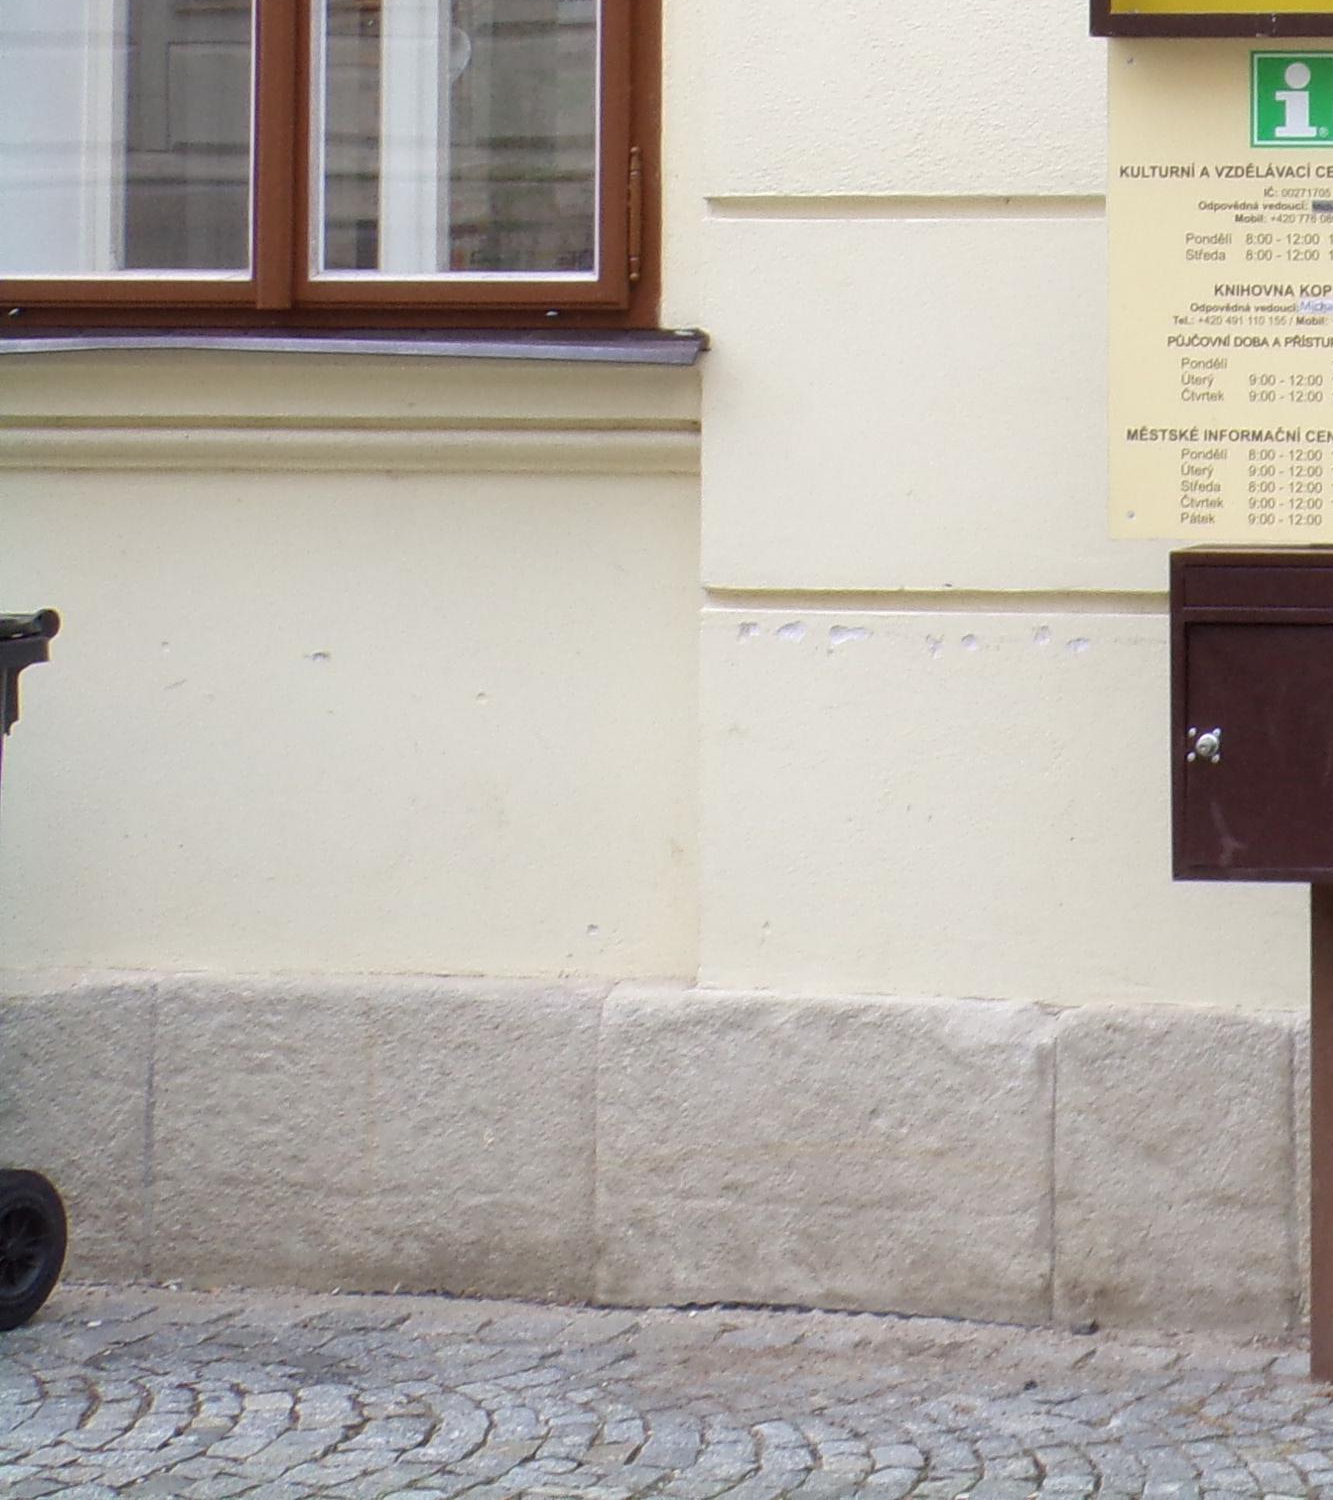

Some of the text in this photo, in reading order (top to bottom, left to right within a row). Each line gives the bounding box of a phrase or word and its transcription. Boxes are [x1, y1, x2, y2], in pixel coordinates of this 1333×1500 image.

[1120, 164, 1195, 178] KULTURNÍ
[1200, 166, 1210, 178] A
[1215, 164, 1310, 178] VZDĚLÁVACÍ
[1186, 233, 1232, 245] Pondělí
[1246, 233, 1272, 245] 8:00
[1286, 233, 1320, 245] 12:00
[1186, 249, 1225, 261] Středa
[1246, 249, 1272, 261] 8:00
[1286, 249, 1320, 261] 12:00
[1215, 284, 1294, 296] KNIHOVNA
[1234, 337, 1269, 347] DOBA
[1272, 337, 1281, 347] A
[1181, 357, 1227, 370] Pondělí
[1181, 373, 1214, 388] Úterý
[1249, 374, 1276, 386] 9:00
[1290, 375, 1323, 386] 12:00
[1181, 389, 1224, 402] Čtvrtek
[1249, 390, 1276, 402] 9:00
[1290, 391, 1323, 402] 12:00
[1127, 427, 1198, 441] MĚSTSKÉ
[1204, 427, 1300, 442] INFORMAČNÍ
[1181, 448, 1227, 460] Pondělí
[1249, 449, 1275, 461] 8:00
[1289, 449, 1322, 461] 12:00
[1181, 464, 1214, 478] Úterý
[1248, 465, 1275, 477] 9:00
[1290, 465, 1323, 477] 12:00
[1181, 480, 1221, 492] Středa
[1248, 481, 1275, 493] 8:00
[1289, 481, 1322, 494] 12:00
[1181, 495, 1223, 508] Čtvrtek
[1249, 497, 1275, 509] 9:00
[1289, 498, 1323, 510] 12:00
[1181, 512, 1215, 524] Pátek
[1248, 513, 1275, 525] 9:00
[1289, 514, 1322, 526] 12:00
